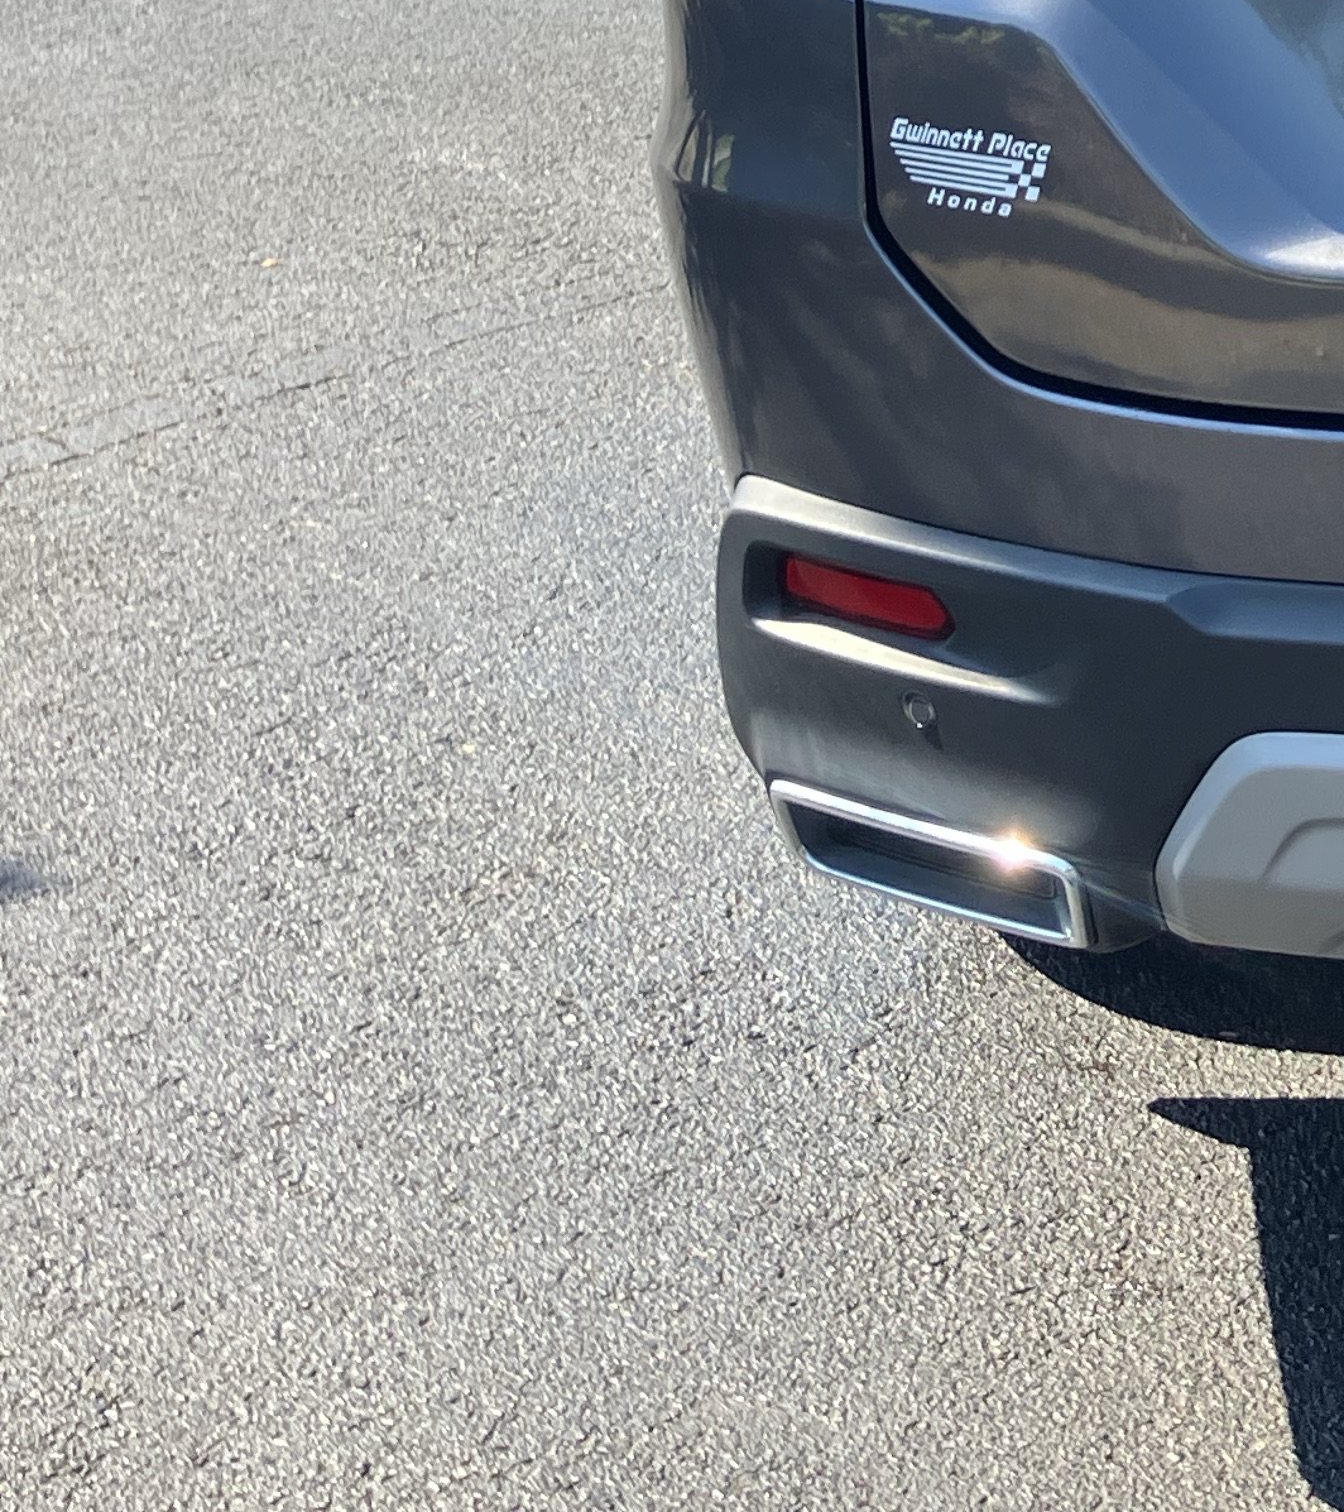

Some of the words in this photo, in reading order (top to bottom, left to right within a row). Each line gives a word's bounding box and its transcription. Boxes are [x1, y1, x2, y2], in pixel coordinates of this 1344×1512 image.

[890, 117, 984, 151] Gwinnett
[987, 132, 1051, 161] Place
[927, 187, 1013, 218] Honda
